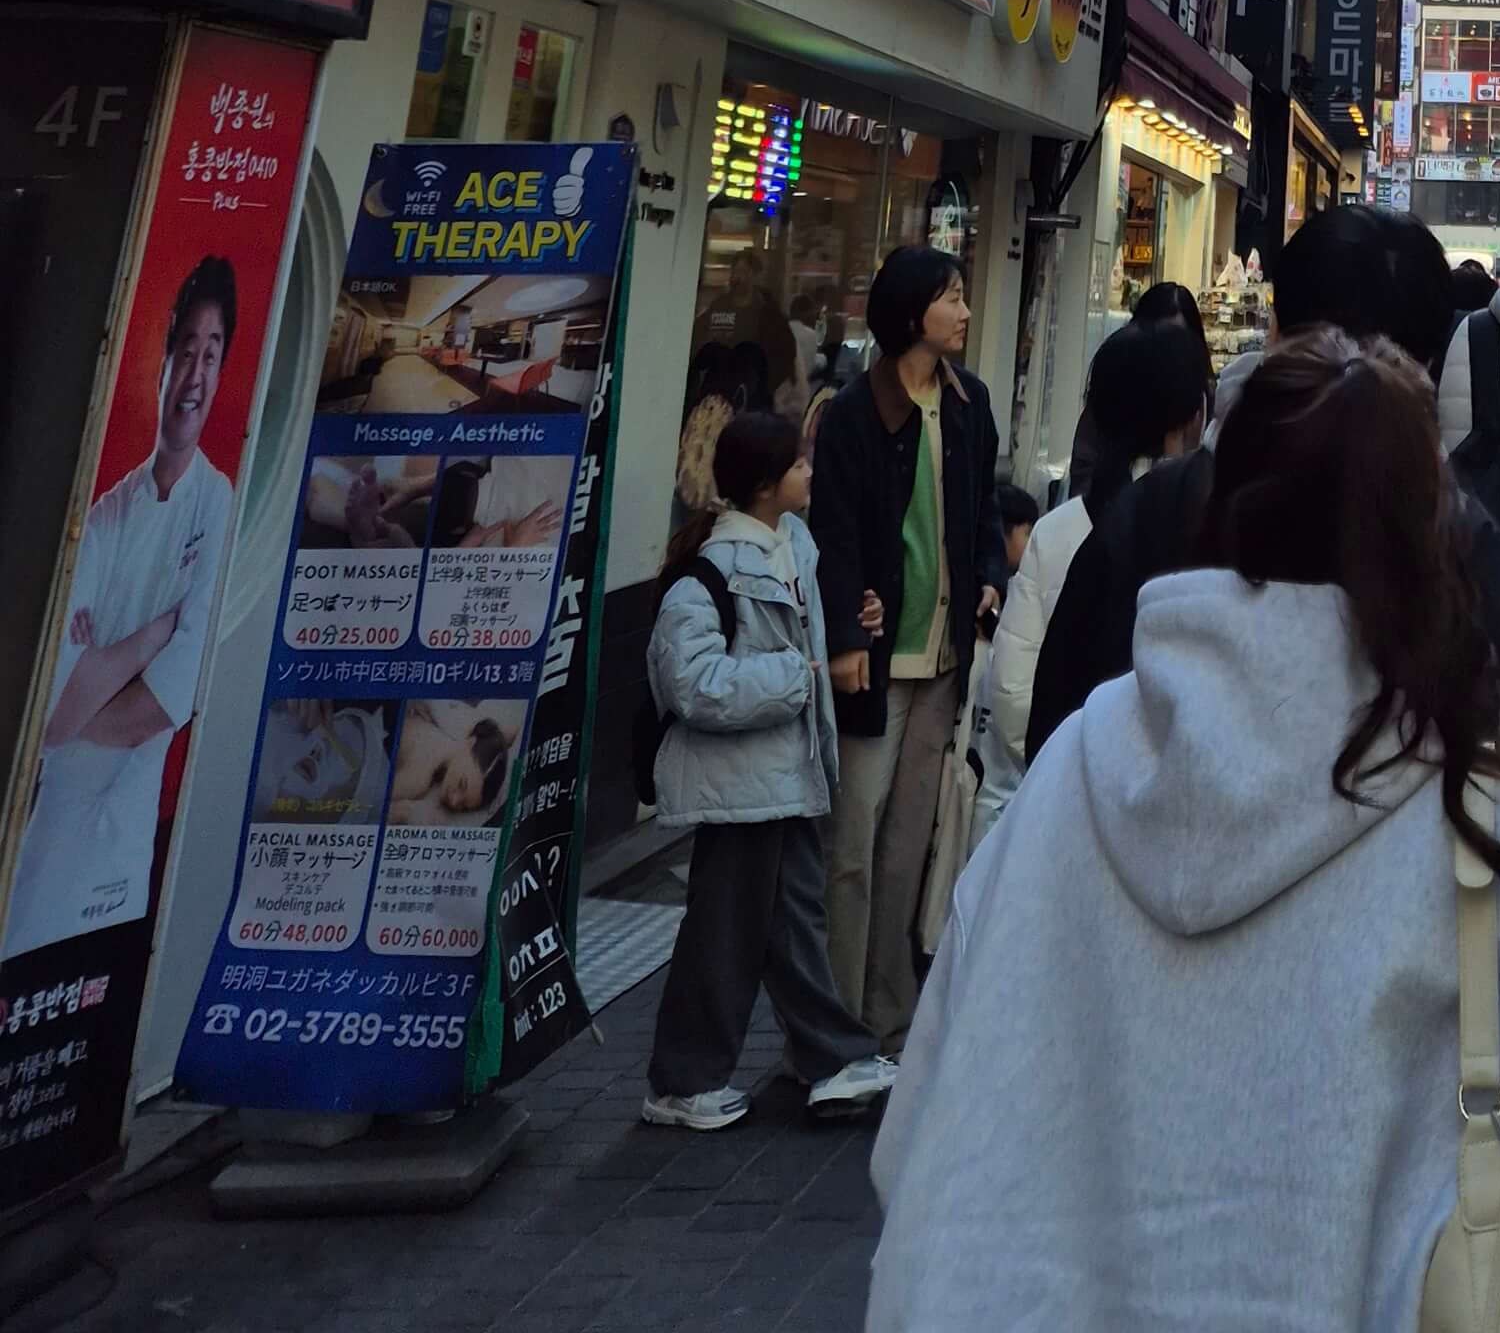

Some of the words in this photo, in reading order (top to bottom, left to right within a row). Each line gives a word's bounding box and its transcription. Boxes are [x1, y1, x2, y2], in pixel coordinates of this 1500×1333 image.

[34, 86, 128, 148] 4F
[405, 190, 441, 202] WI-FI
[453, 170, 545, 210] ACE
[403, 203, 437, 215] FREE
[392, 220, 594, 259] THERAPY
[354, 422, 434, 446] Massage
[450, 422, 546, 443] Aesthetic
[431, 553, 496, 565] BODY+FOOT
[499, 553, 554, 565] MASSAGE
[294, 565, 339, 580] FOOT
[343, 565, 420, 580] MASSAGE
[249, 832, 300, 847] FACIAL
[306, 833, 375, 848] MASSAGE
[386, 828, 428, 840] AROMA
[431, 828, 448, 840] OIL
[450, 829, 496, 842] MASSAGE
[255, 896, 312, 915] Modeling
[315, 897, 346, 915] pack
[537, 980, 568, 1020] 123
[243, 1008, 466, 1050] 02-3789-3555
